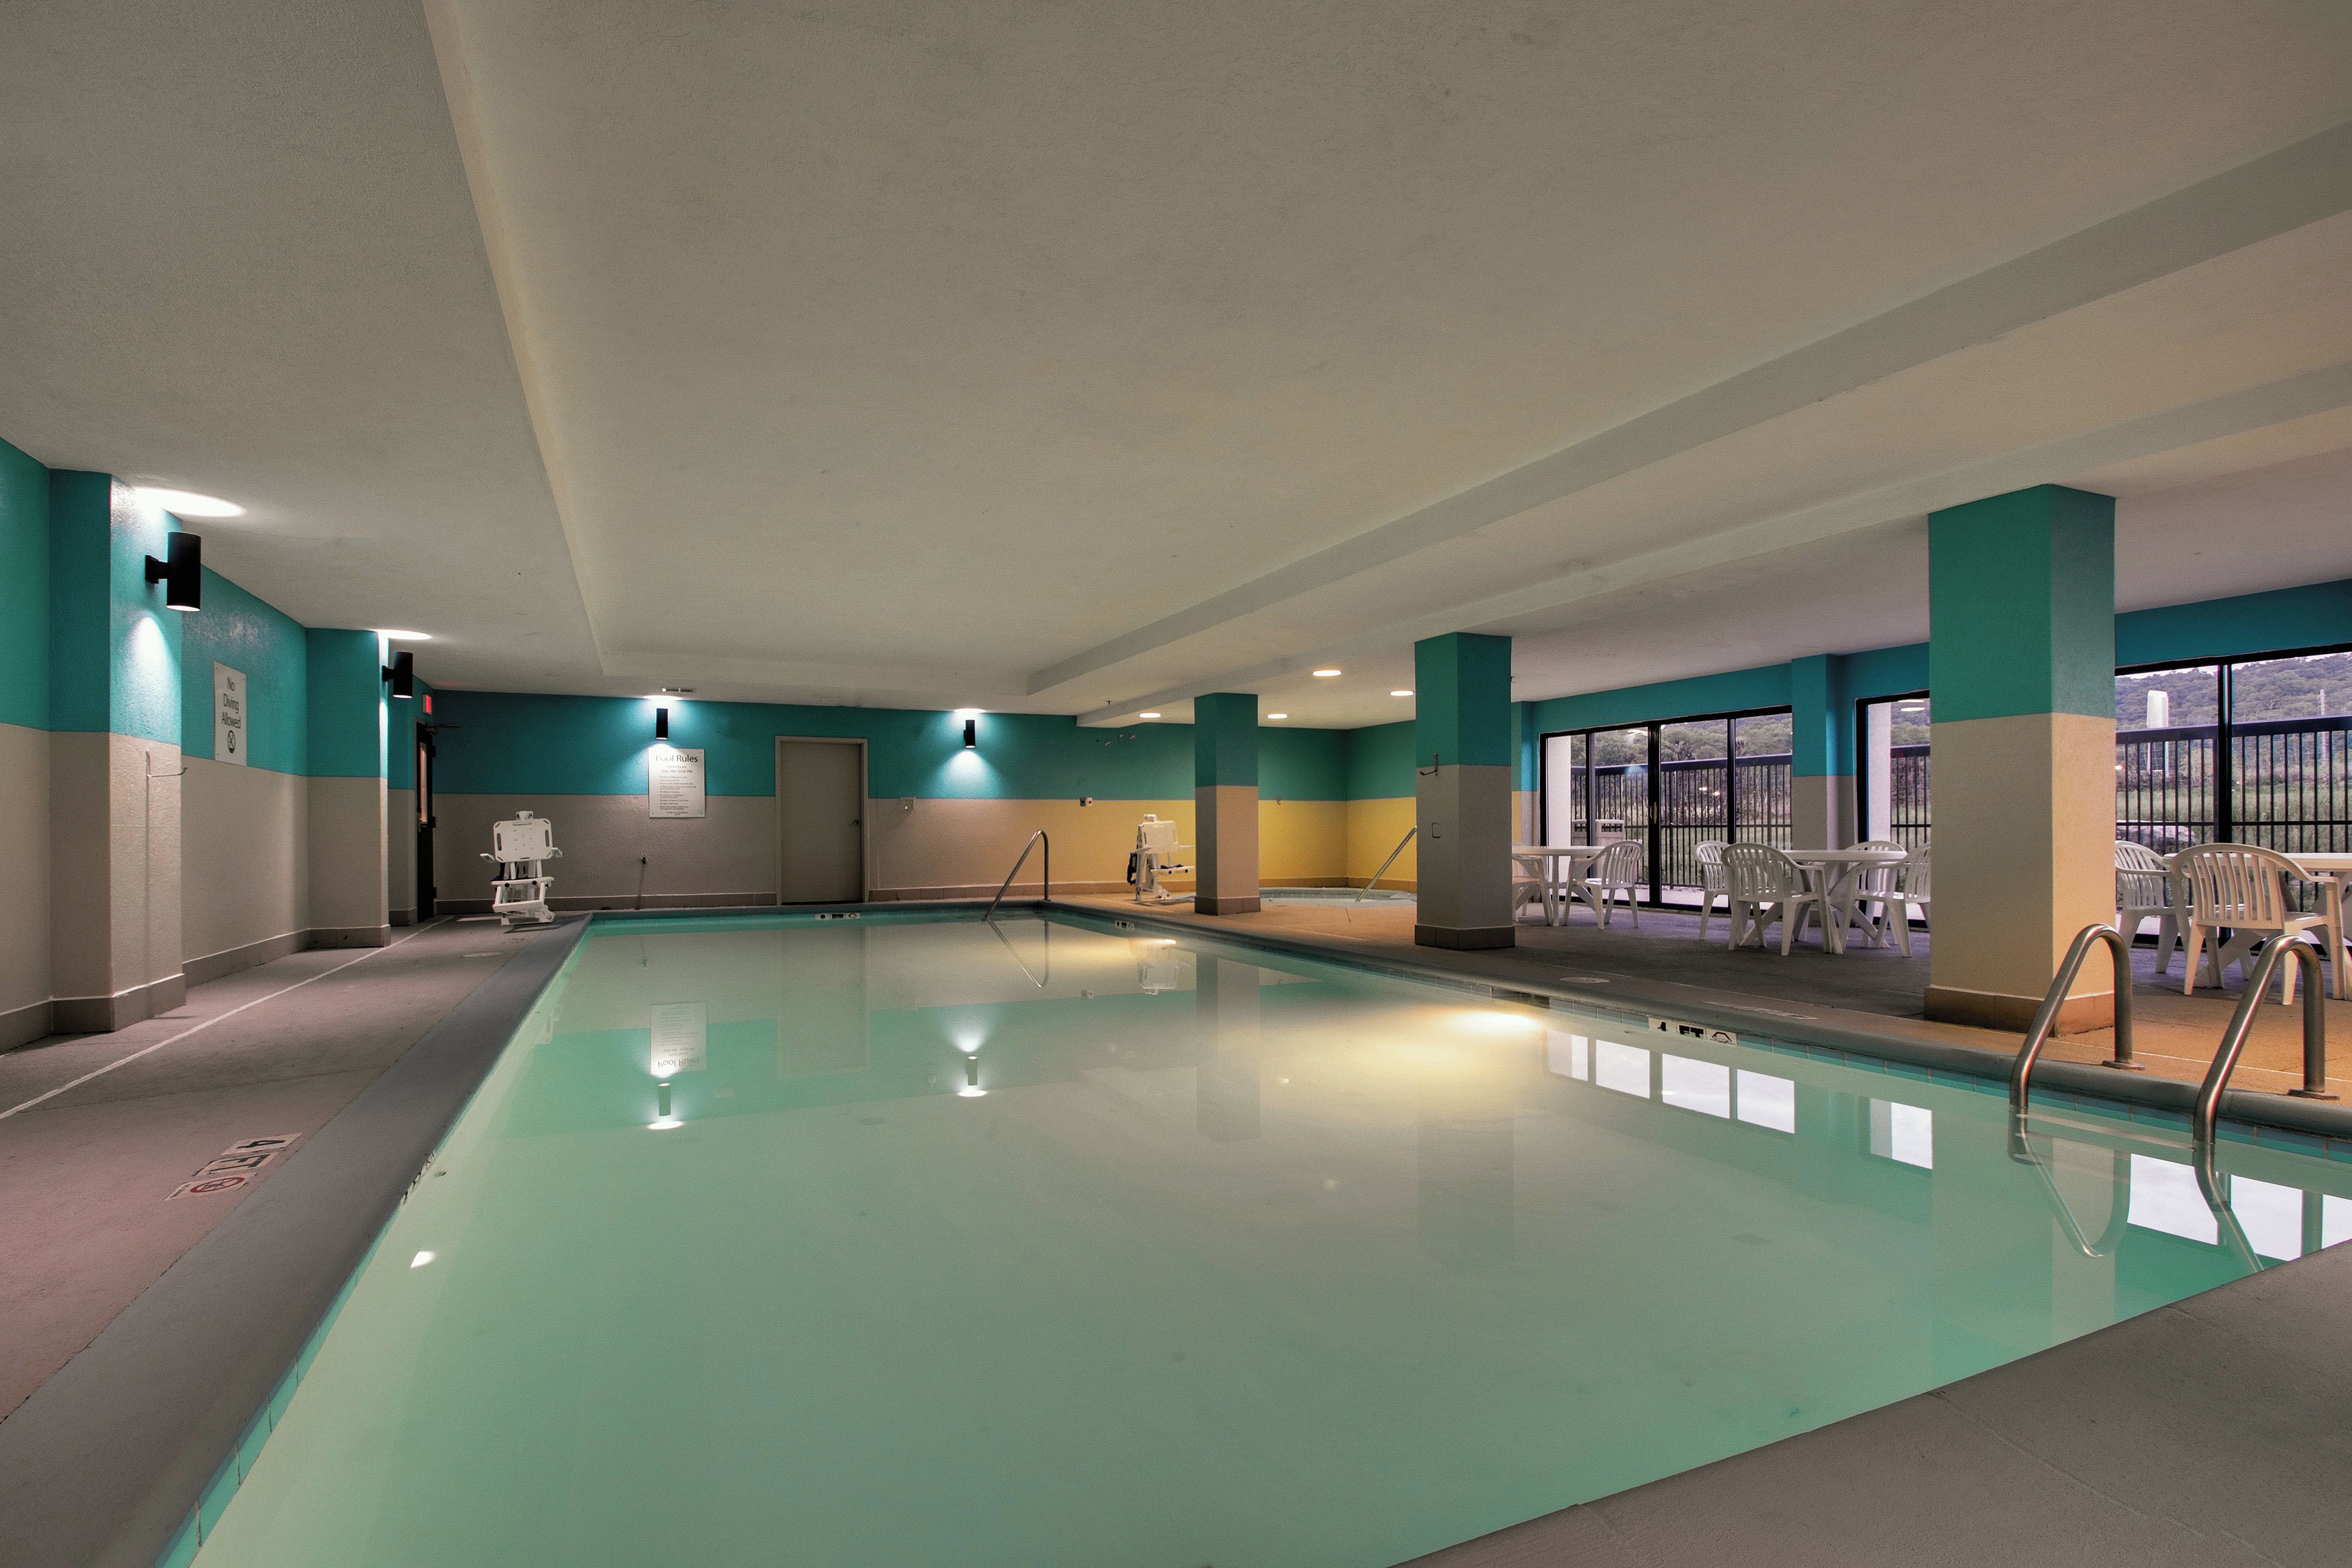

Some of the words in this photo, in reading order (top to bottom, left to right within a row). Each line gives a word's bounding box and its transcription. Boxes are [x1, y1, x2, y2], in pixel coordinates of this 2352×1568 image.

[227, 677, 235, 692] No
[223, 693, 239, 714] Diving
[222, 711, 241, 729] Allowed
